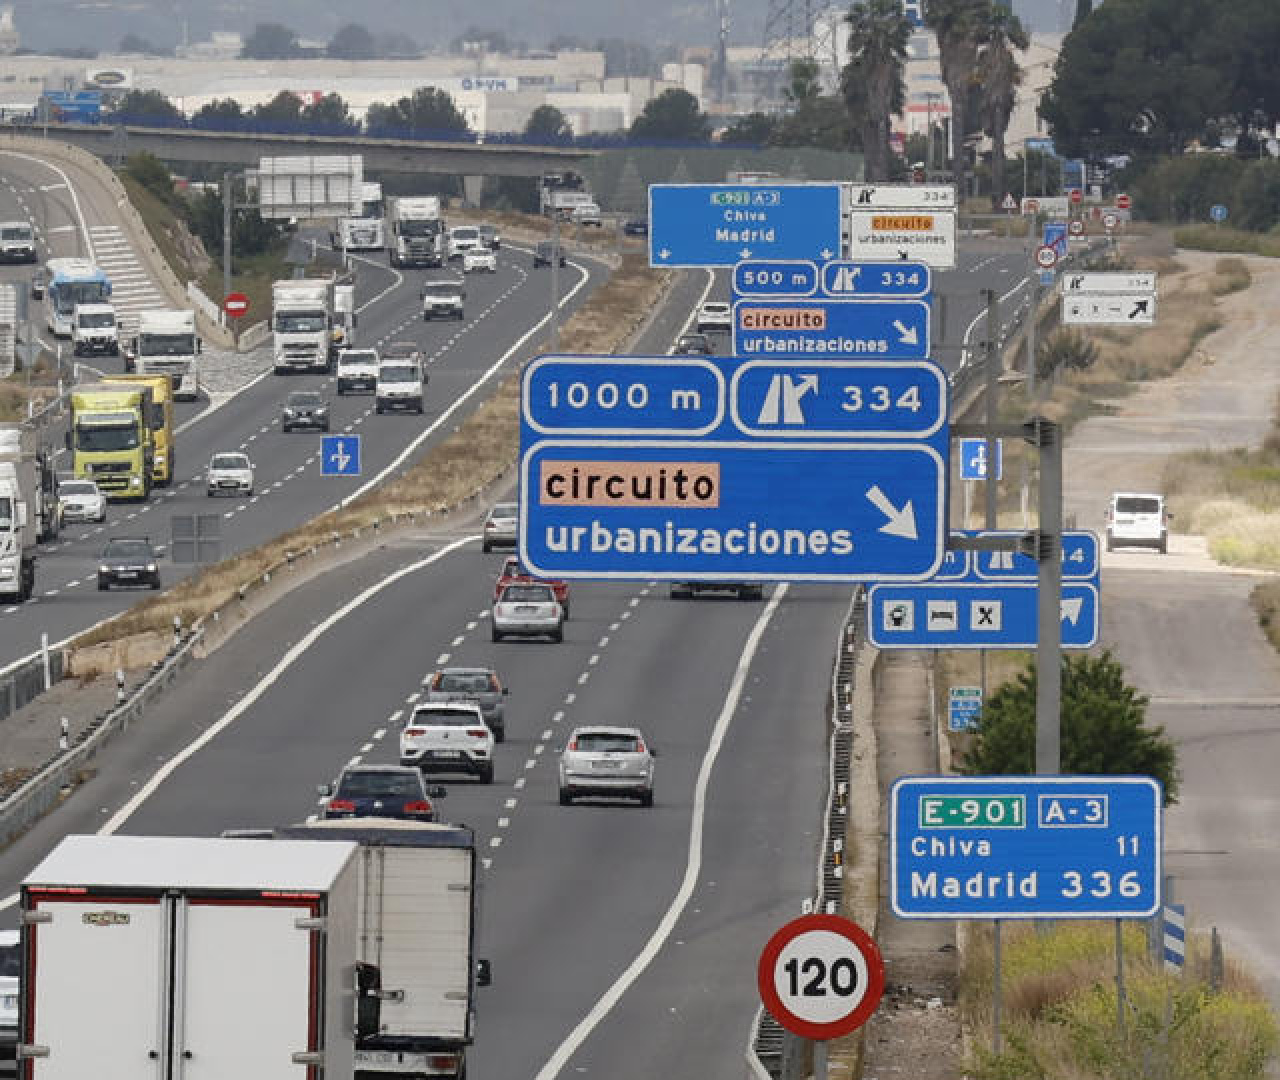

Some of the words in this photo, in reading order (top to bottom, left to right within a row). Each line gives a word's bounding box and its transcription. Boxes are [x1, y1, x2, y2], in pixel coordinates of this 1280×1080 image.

[723, 210, 767, 222] Chiva
[872, 217, 933, 229] circuito
[715, 228, 775, 242] Madrid
[743, 271, 783, 285] 500
[791, 273, 808, 285] m
[881, 272, 919, 286] 334
[743, 311, 824, 327] circuito
[743, 336, 889, 353] urbanizaciones
[547, 382, 648, 410] 1000
[670, 389, 702, 411] m
[842, 383, 923, 413] 334
[546, 466, 716, 502] circuito
[545, 520, 854, 556] urbanizaciones
[924, 800, 1024, 824] E-901
[1044, 801, 1104, 823] A-3
[910, 836, 992, 857] Chiva
[1116, 835, 1140, 857] 11
[910, 871, 1039, 898] Madrid
[1061, 871, 1143, 898] 336
[783, 957, 861, 997] 120
